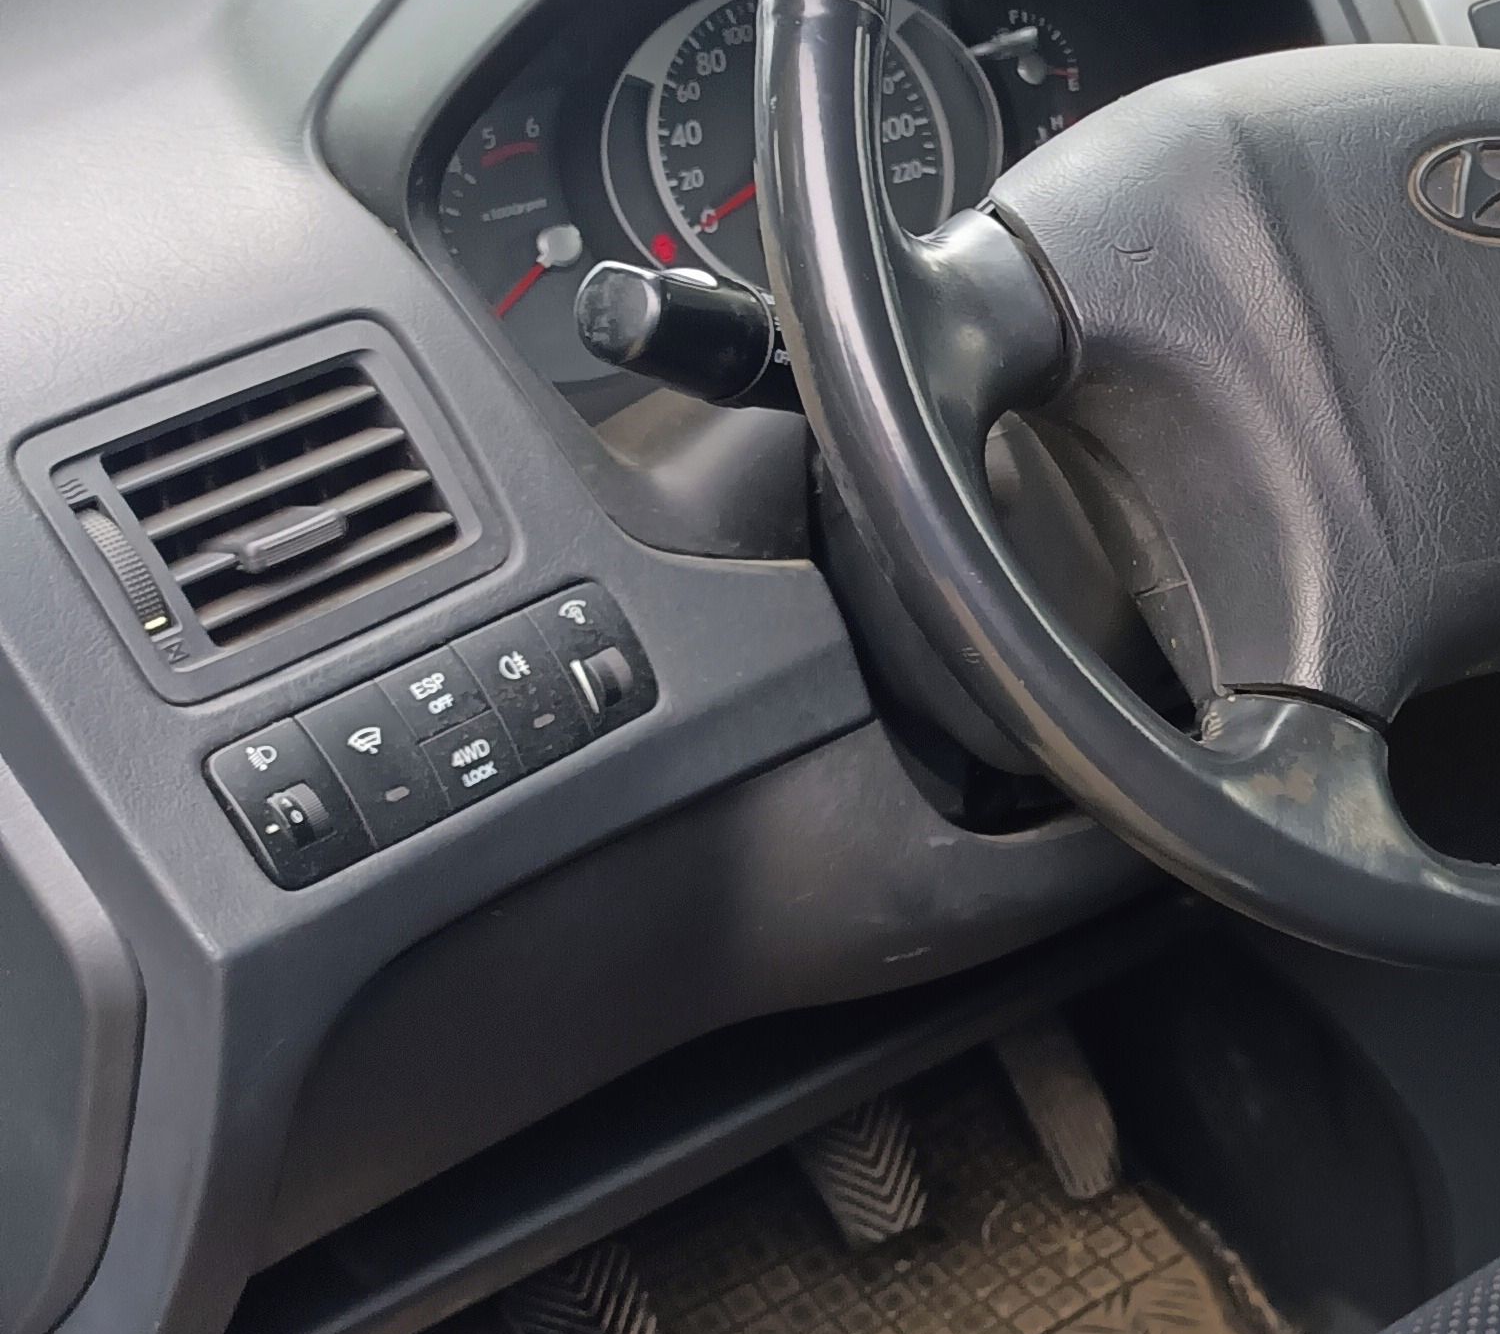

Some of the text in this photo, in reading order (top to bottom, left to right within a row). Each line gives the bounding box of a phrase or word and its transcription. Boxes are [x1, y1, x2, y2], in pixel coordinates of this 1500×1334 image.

[696, 49, 727, 76] 80
[677, 81, 701, 103] 60
[482, 126, 497, 150] 5
[526, 115, 540, 138] 6
[670, 119, 703, 147] 40
[679, 168, 705, 191] 20
[891, 161, 922, 184] 220
[700, 209, 719, 234] 0
[409, 672, 446, 701] ESP
[428, 693, 455, 715] OFF
[451, 738, 491, 768] 4WD
[461, 760, 498, 788] LOCK
